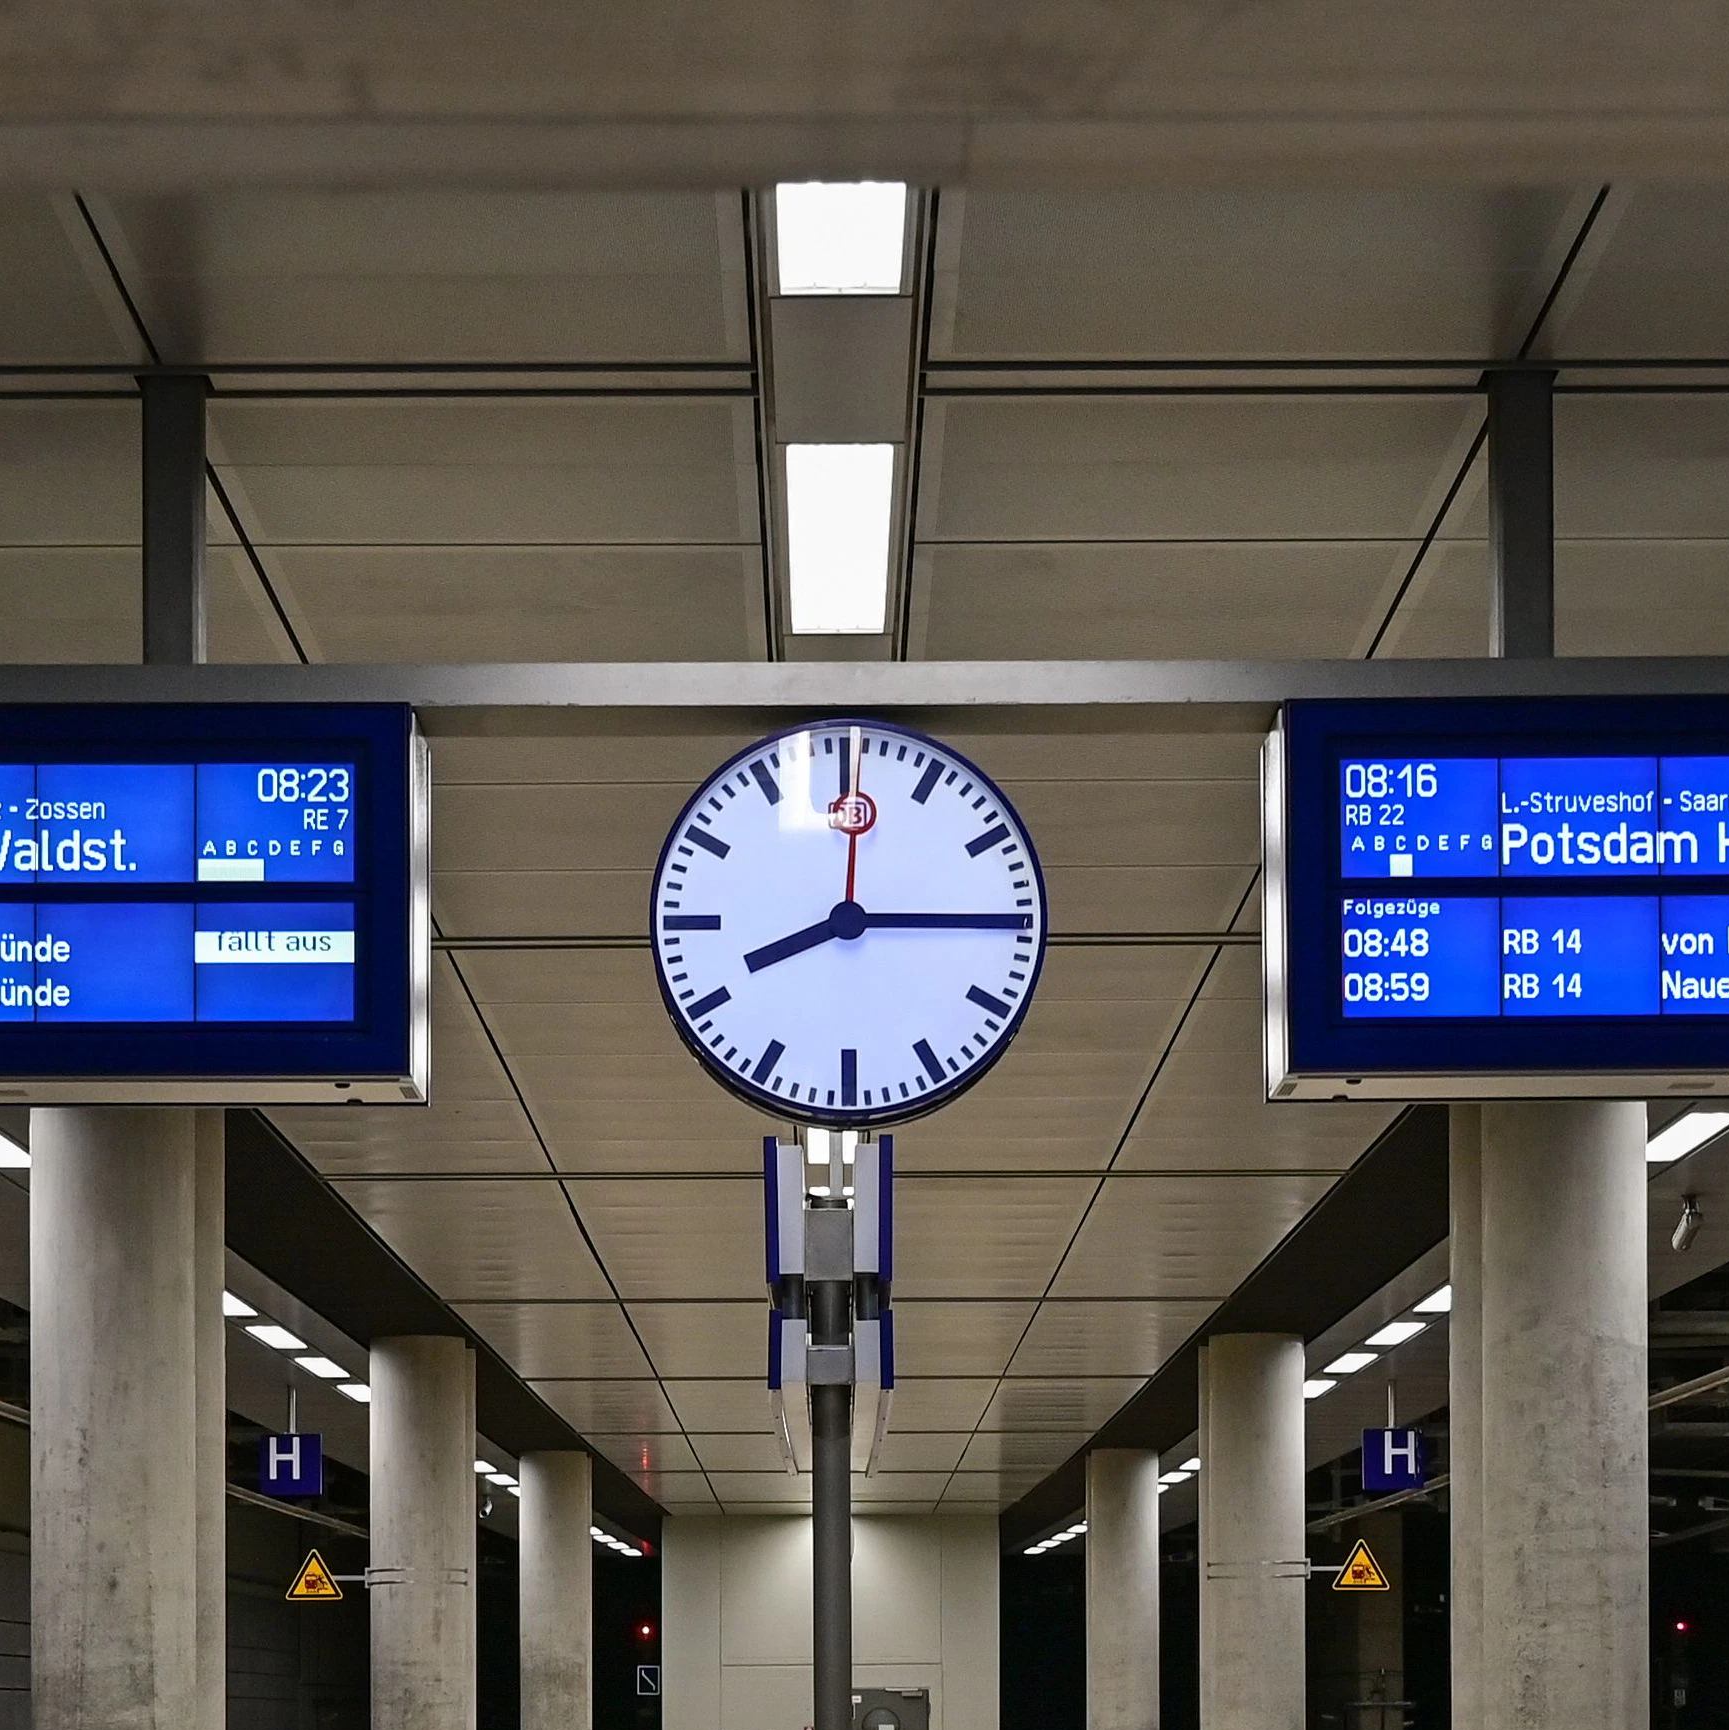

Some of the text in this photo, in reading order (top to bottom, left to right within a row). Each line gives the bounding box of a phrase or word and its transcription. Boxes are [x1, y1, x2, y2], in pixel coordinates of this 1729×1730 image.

[257, 768, 349, 802] 08:23
[1345, 763, 1438, 798] 08:16
[25, 798, 105, 820] Zossen
[1501, 790, 1654, 814] L.-Struveshof
[303, 808, 349, 830] RE 7
[1345, 804, 1405, 826] RB 22
[202, 839, 344, 856] A B C D E F G
[1351, 834, 1493, 852] A B C D E F G
[1502, 822, 1698, 865] Potsdam
[1343, 898, 1440, 919] Folgezüge
[286, 935, 332, 952] aus
[1343, 928, 1429, 958] 08:48
[1503, 928, 1582, 955] RB 14
[1661, 932, 1714, 955] von
[1344, 972, 1430, 1002] 08:59
[1503, 972, 1582, 999] RB 14
[269, 1436, 301, 1480] H
[1384, 1430, 1415, 1475] H
